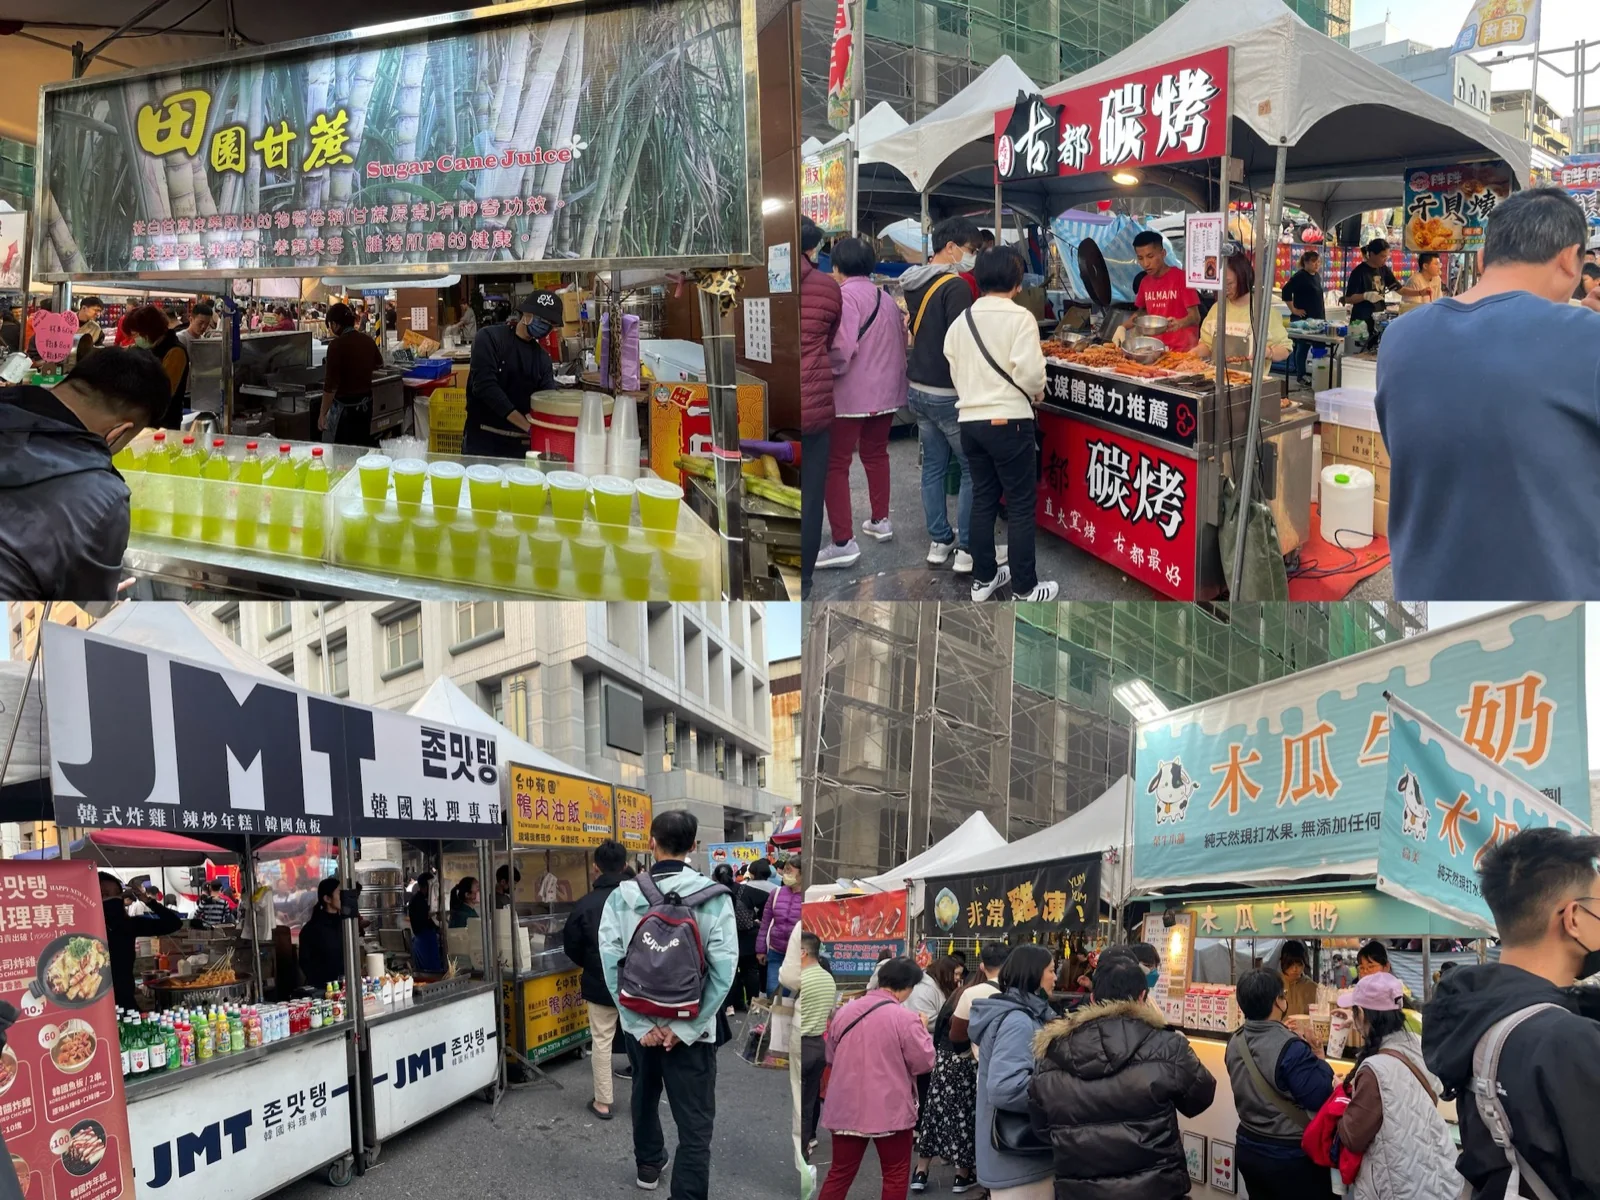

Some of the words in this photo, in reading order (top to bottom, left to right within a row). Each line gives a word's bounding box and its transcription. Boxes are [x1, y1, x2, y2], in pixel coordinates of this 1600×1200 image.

[138, 90, 354, 173] 田園甘蔗
[1014, 67, 1221, 174] 古都碳烤
[366, 158, 434, 179] Sugar
[436, 153, 498, 172] Cane
[500, 145, 573, 167] Juice
[1144, 290, 1178, 301] BALMAIN
[1086, 441, 1185, 538] 碳烤
[1113, 532, 1183, 587] 古都最好
[57, 638, 376, 814] JMT
[420, 725, 498, 786] 존맛탱
[77, 803, 167, 828] 韓式炸雞
[182, 809, 253, 831] 辣炒年糕
[264, 815, 321, 834] 韓國魚板
[370, 792, 500, 825] 韓國料理專賣
[516, 793, 580, 823] 鴨肉油飯
[1301, 811, 1382, 838] 無添加任何
[0, 875, 47, 899] 맛탱
[1067, 872, 1086, 889] YUM
[1437, 863, 1485, 898] 純天然現打水
[1200, 900, 1338, 934] 木瓜牛奶
[451, 1026, 485, 1057] 존맛탱
[393, 1041, 447, 1089] JMT
[262, 1081, 328, 1129] 존맛탱
[262, 1107, 328, 1142] 韓國料理專賣
[146, 1109, 253, 1189] JMT
[1216, 1178, 1230, 1188] Fruit
